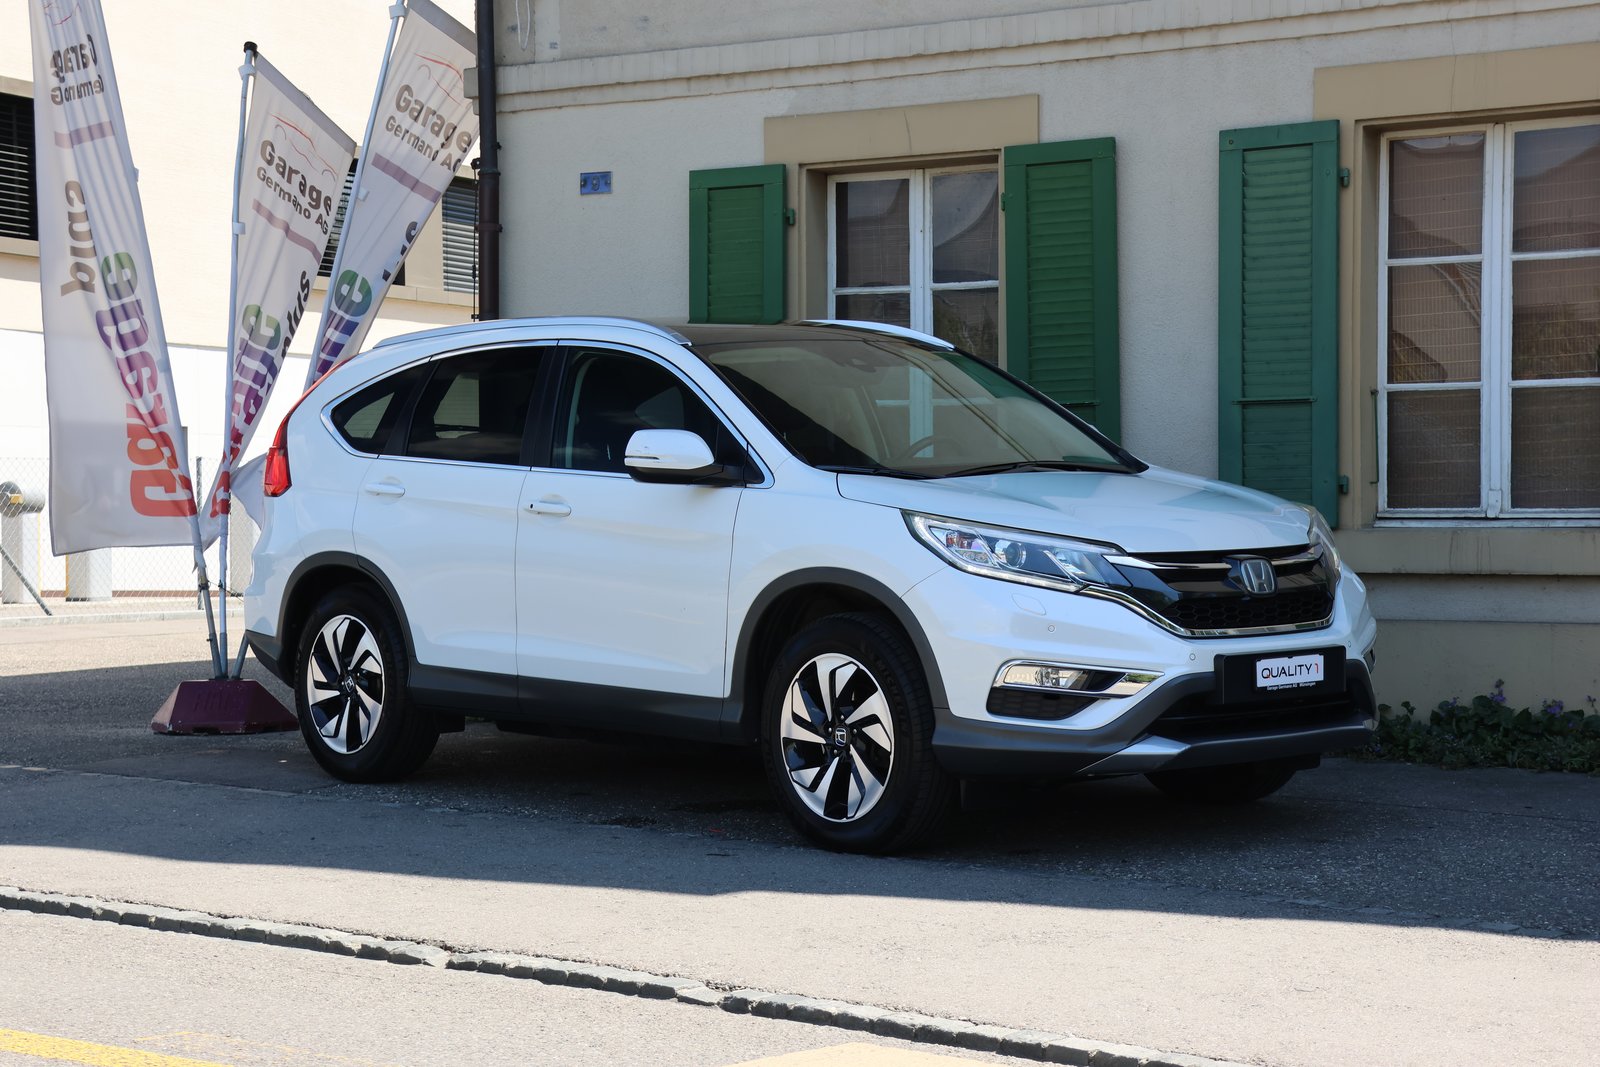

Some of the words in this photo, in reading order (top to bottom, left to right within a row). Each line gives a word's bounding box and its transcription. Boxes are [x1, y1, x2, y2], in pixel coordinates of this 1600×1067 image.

[385, 115, 439, 162] Germano
[396, 84, 472, 153] Garage
[256, 167, 311, 220] Germano
[315, 213, 329, 236] AG
[260, 140, 332, 216] Garage
[1261, 663, 1312, 679] QUALITY
